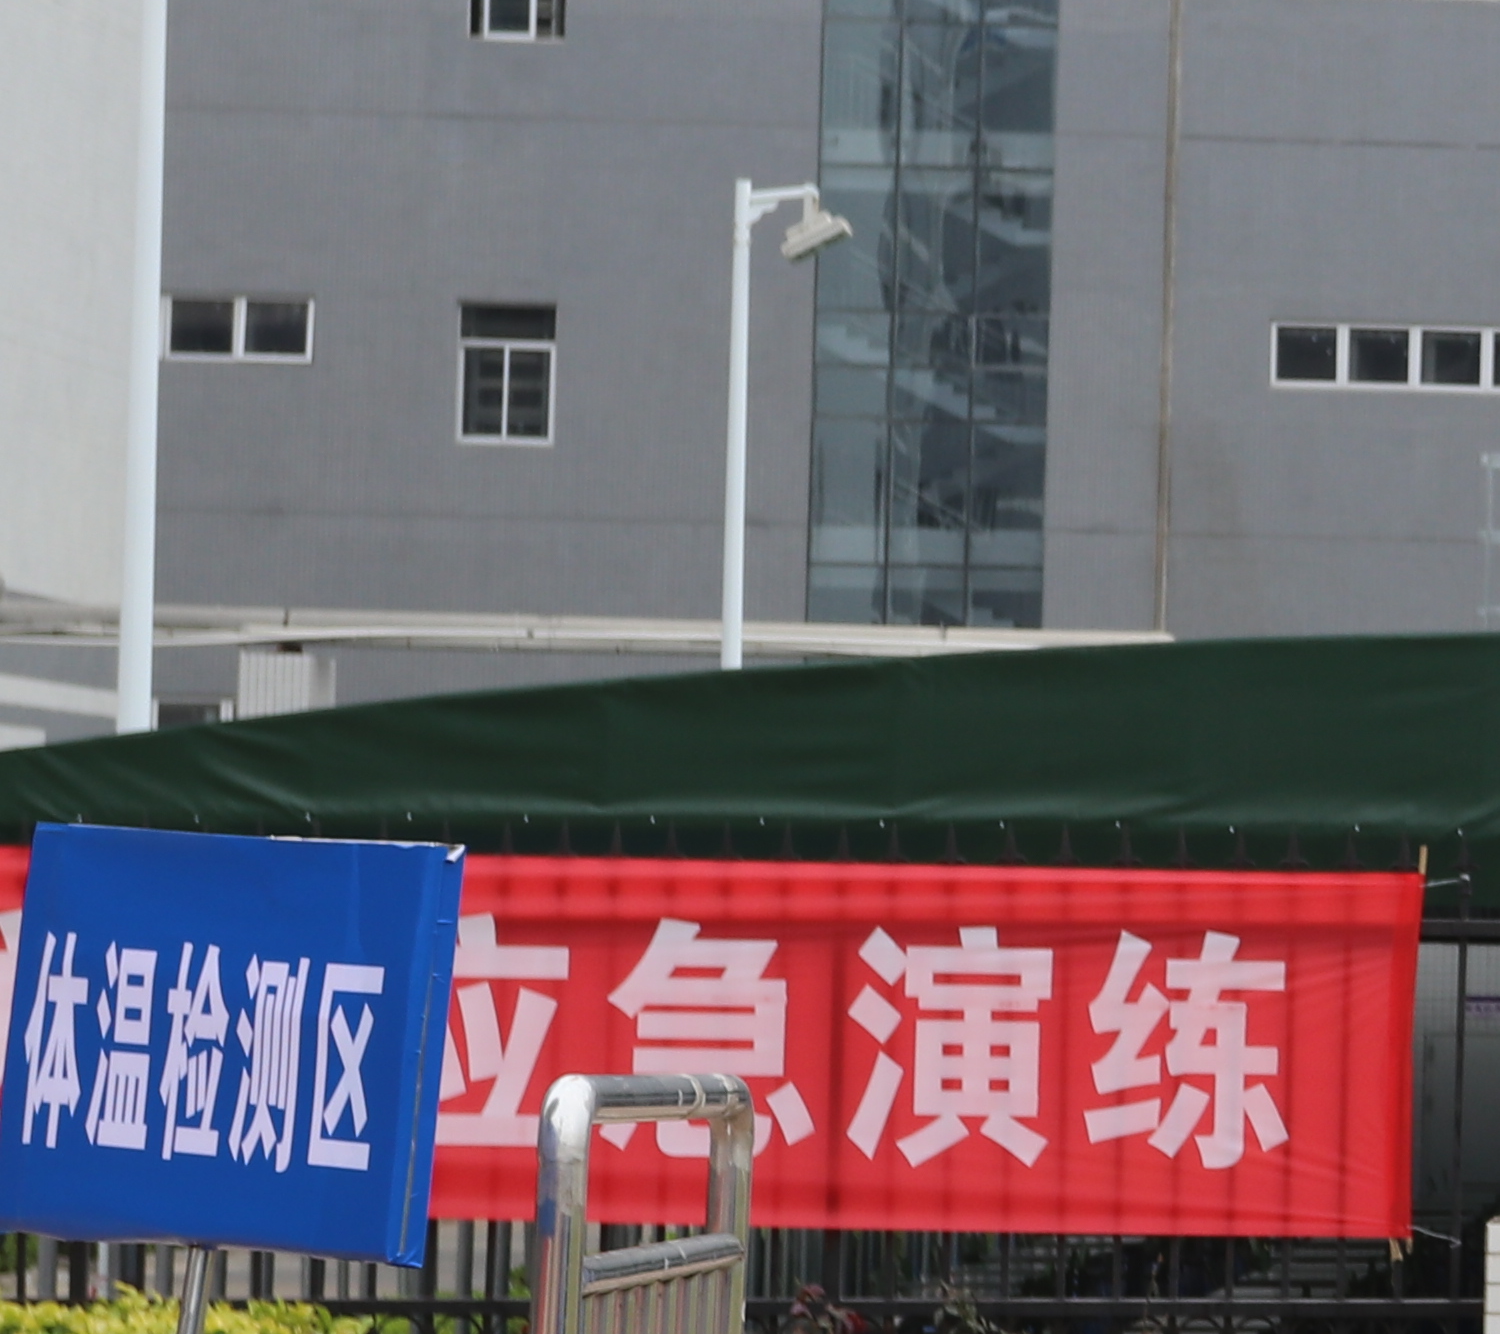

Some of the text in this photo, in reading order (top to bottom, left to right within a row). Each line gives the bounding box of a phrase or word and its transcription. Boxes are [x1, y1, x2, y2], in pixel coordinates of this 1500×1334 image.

[22, 931, 385, 1173] 体温检测区
[435, 913, 1290, 1169] 应急演练
